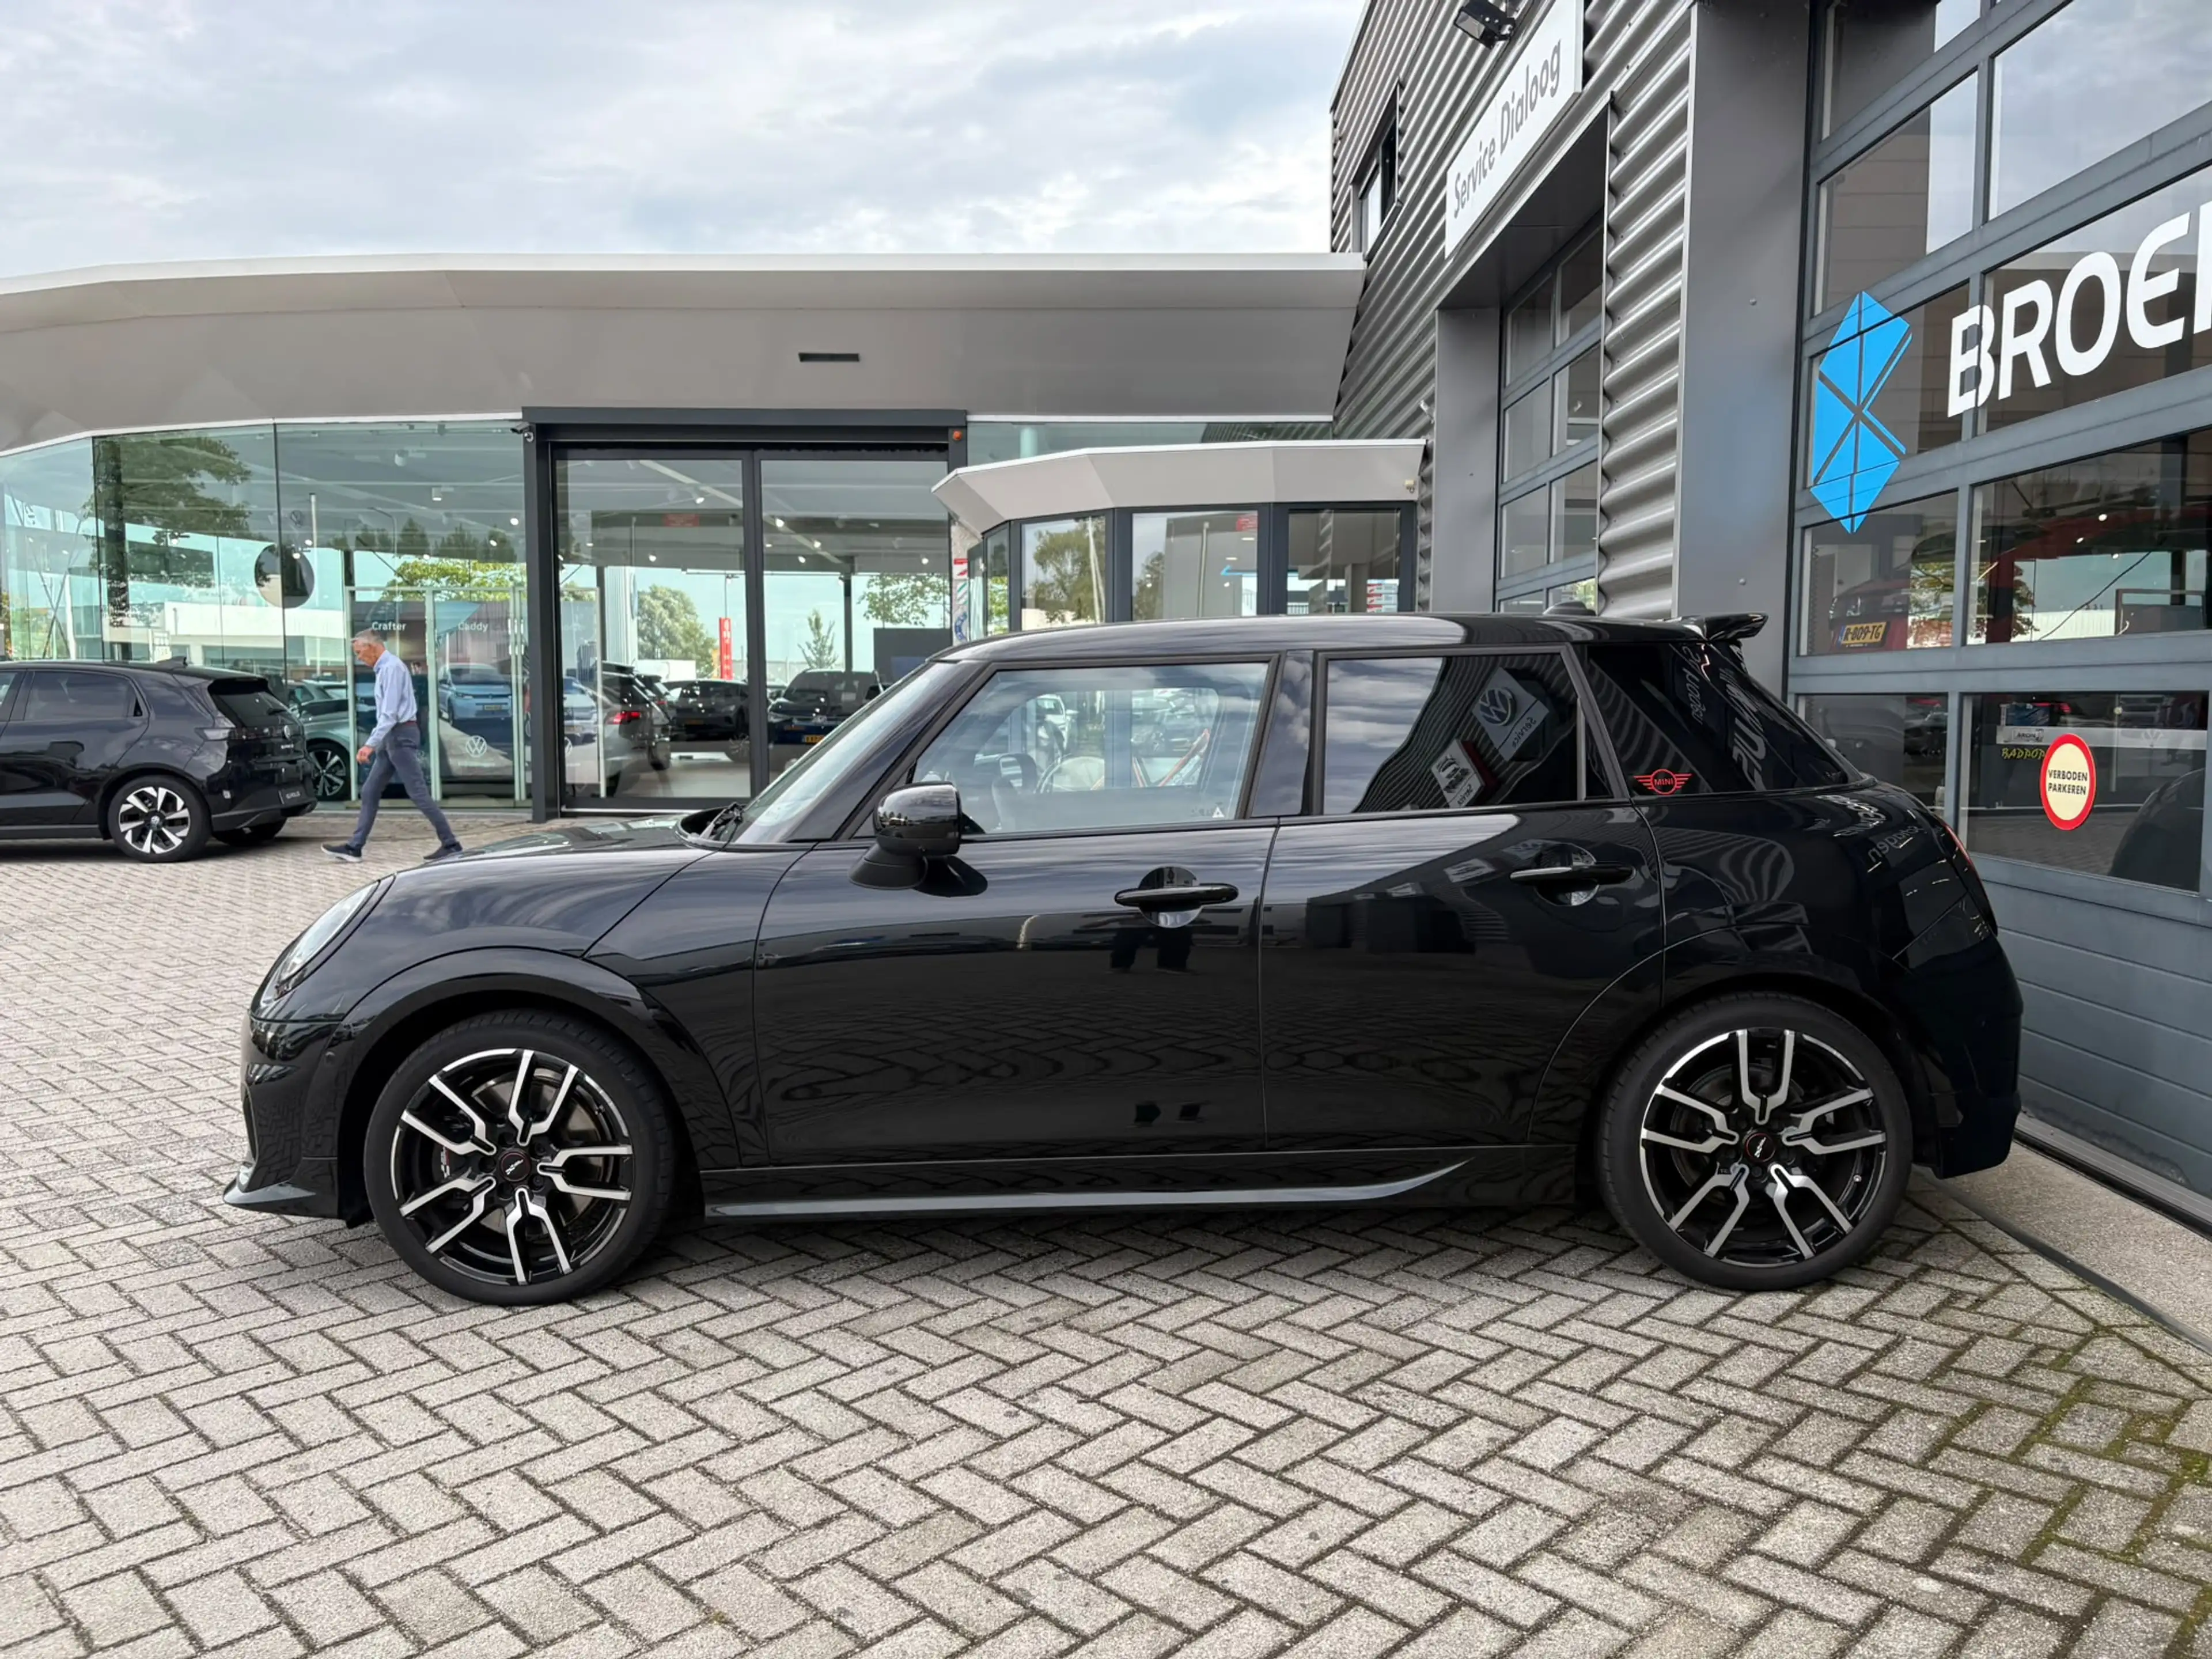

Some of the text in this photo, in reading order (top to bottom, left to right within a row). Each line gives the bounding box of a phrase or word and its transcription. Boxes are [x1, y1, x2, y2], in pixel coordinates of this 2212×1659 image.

[1454, 39, 1561, 219] Service Dialoog
[372, 622, 407, 631] Crafter
[458, 622, 488, 632] Caddy
[2048, 770, 2088, 782] VERBODEN
[1654, 778, 1674, 786] MINI
[2048, 783, 2086, 795] PARKEREN
